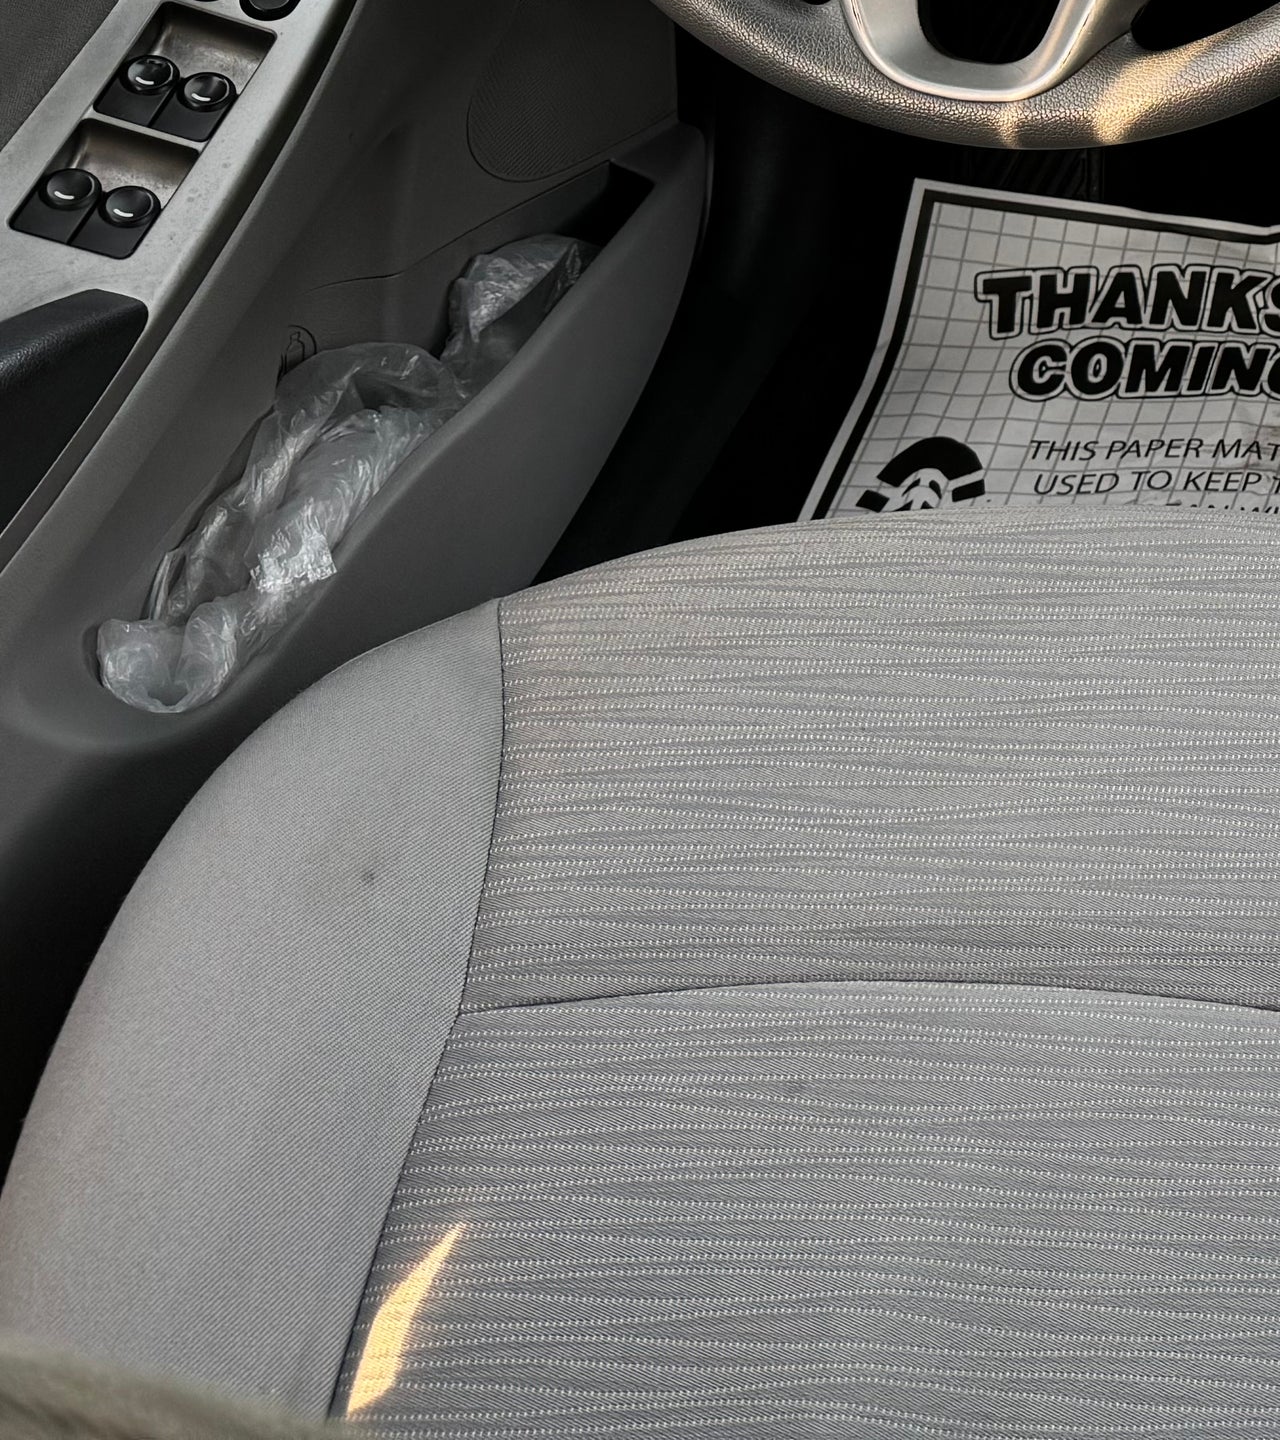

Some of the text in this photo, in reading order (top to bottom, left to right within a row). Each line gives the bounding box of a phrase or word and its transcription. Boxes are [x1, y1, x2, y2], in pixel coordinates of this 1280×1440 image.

[1030, 439, 1100, 461] THIS
[1105, 438, 1204, 461] PAPER
[1033, 472, 1120, 496] USED
[1131, 471, 1173, 492] TO
[1182, 471, 1262, 493] KEEP
